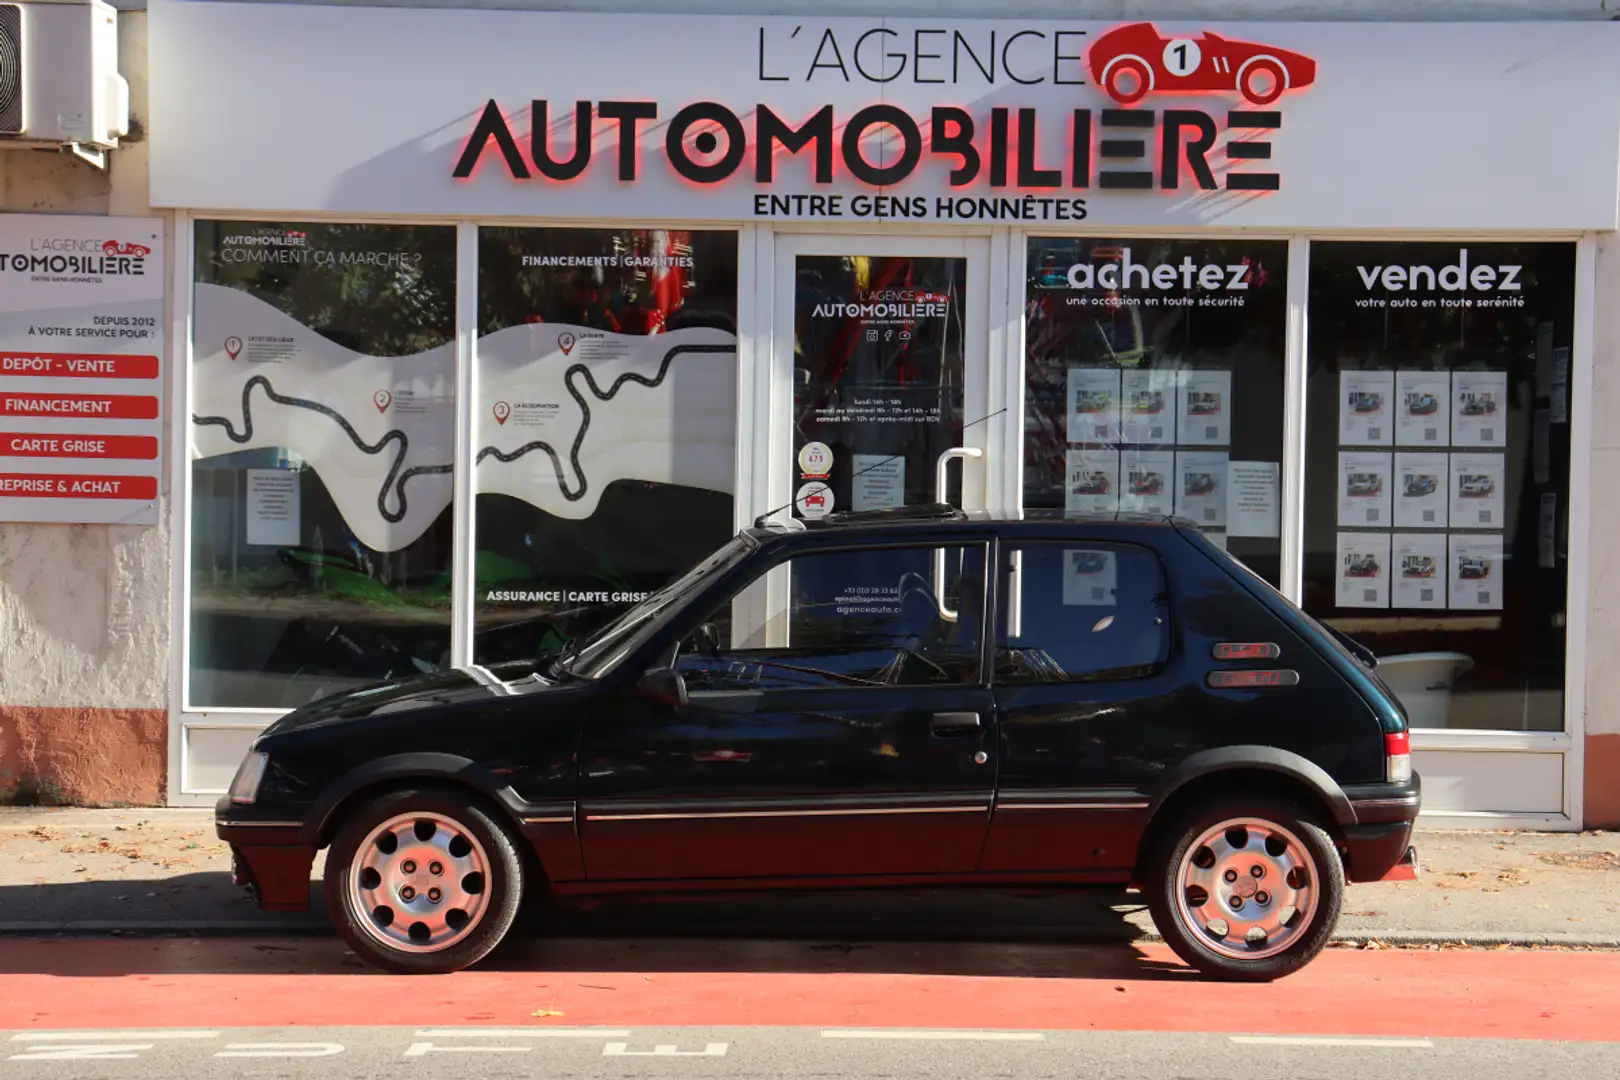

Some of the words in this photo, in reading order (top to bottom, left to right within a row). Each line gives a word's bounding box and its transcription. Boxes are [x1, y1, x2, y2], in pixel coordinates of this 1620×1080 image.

[757, 27, 1088, 85] L'AGENCE
[1173, 42, 1187, 71] 1
[754, 194, 843, 217] ENTRE
[851, 195, 928, 219] GENS
[935, 193, 1088, 221] HONNÊTES
[30, 238, 104, 253] L'AGENCE
[221, 248, 311, 264] COMMENT
[339, 252, 410, 267] MARCHE
[522, 255, 617, 266] FINANCEMENTS
[624, 256, 694, 268] GARANTIES
[1067, 247, 1249, 290] achetez
[1356, 248, 1523, 291] vendez
[860, 290, 914, 301] L'AGENCE
[1066, 297, 1087, 306] une
[1092, 296, 1141, 306] occasion
[1145, 298, 1159, 306] en
[1163, 296, 1194, 306] toute
[1199, 294, 1245, 307] sécurité
[1355, 298, 1386, 308] votre
[1390, 298, 1418, 308] auto
[1421, 299, 1436, 308] en
[1440, 298, 1473, 308] toute
[93, 316, 129, 326] DEPUIS
[132, 317, 155, 326] 2012
[38, 328, 72, 336] VOTRE
[75, 328, 116, 337] SERVICE
[119, 329, 148, 338] POUR
[67, 360, 116, 372] VENTE
[5, 399, 112, 413] FINANCEMENT
[10, 439, 59, 452] CARTE
[62, 440, 106, 453] GRISE
[57, 481, 67, 492] &
[71, 481, 121, 493] ACHAT
[487, 590, 560, 601] ASSURANCE
[569, 591, 609, 602] CARTE
